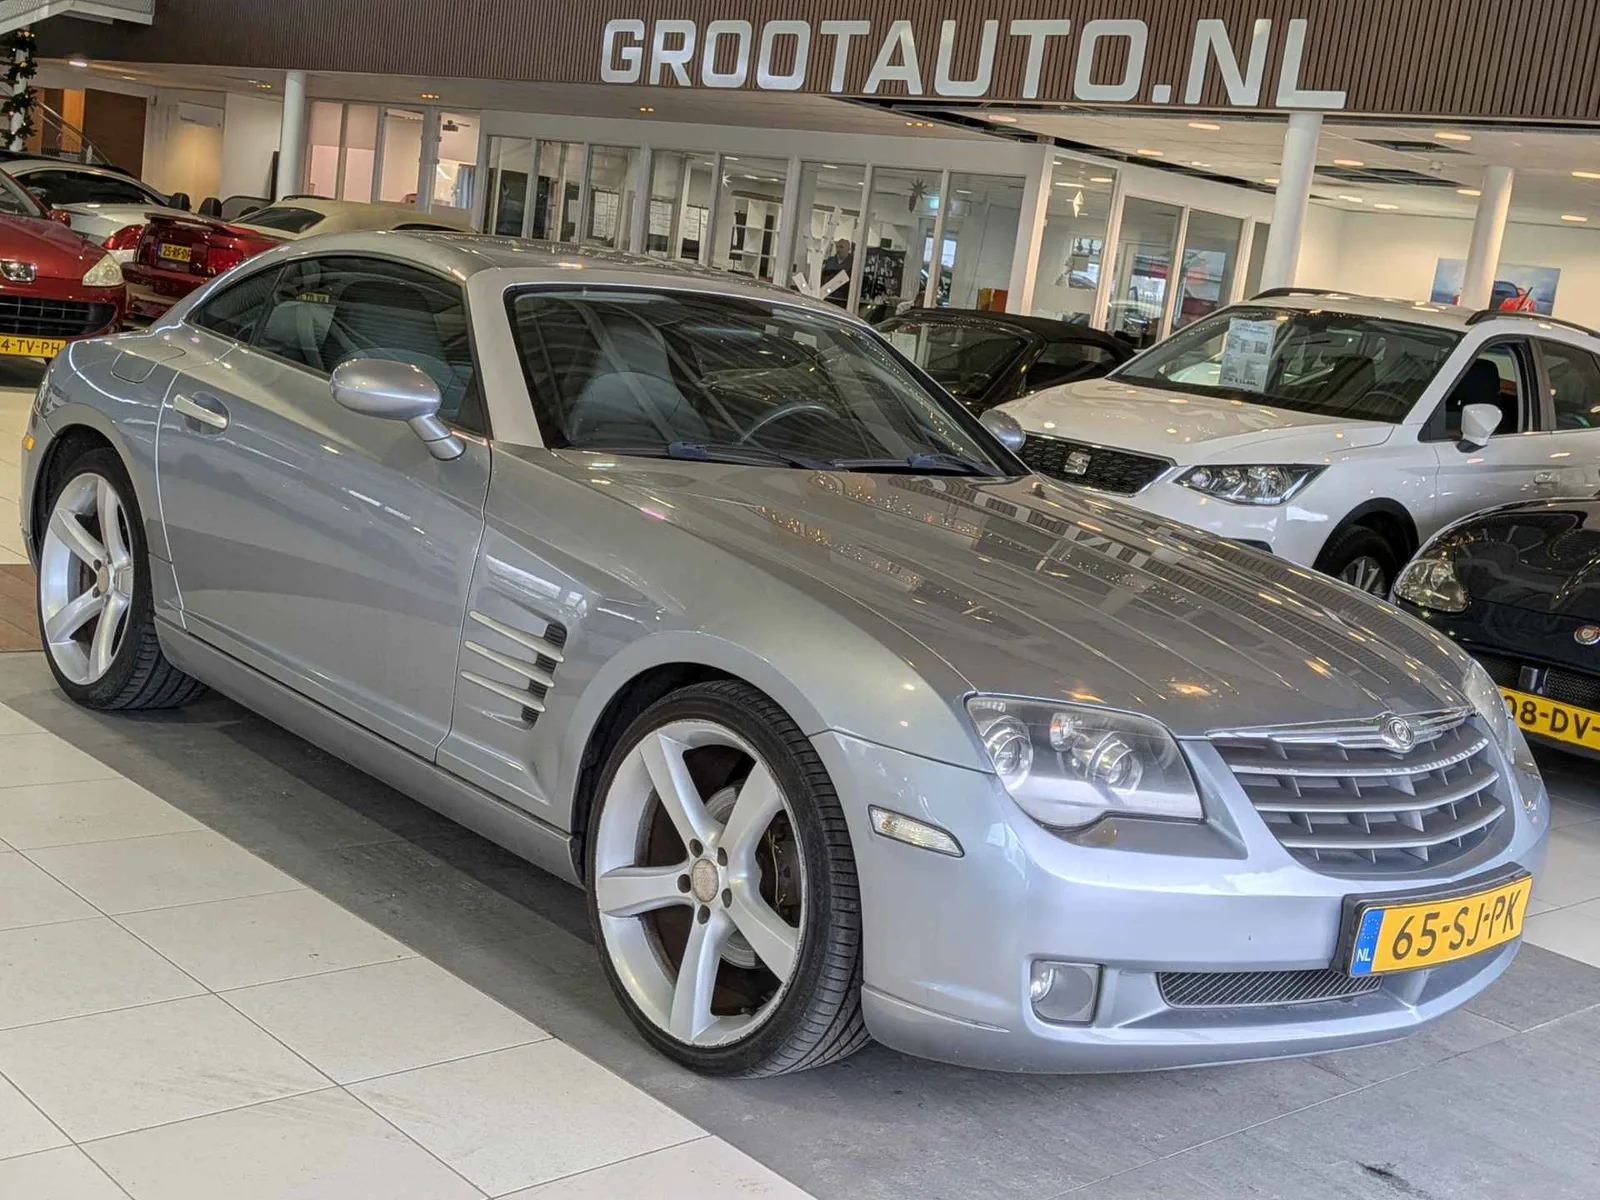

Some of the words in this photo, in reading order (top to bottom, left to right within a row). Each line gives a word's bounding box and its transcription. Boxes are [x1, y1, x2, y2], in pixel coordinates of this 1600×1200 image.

[600, 18, 1347, 109] GROOTAUTO.NL
[1356, 949, 1371, 962] NL
[1392, 889, 1522, 960] 65-SJ-PK
